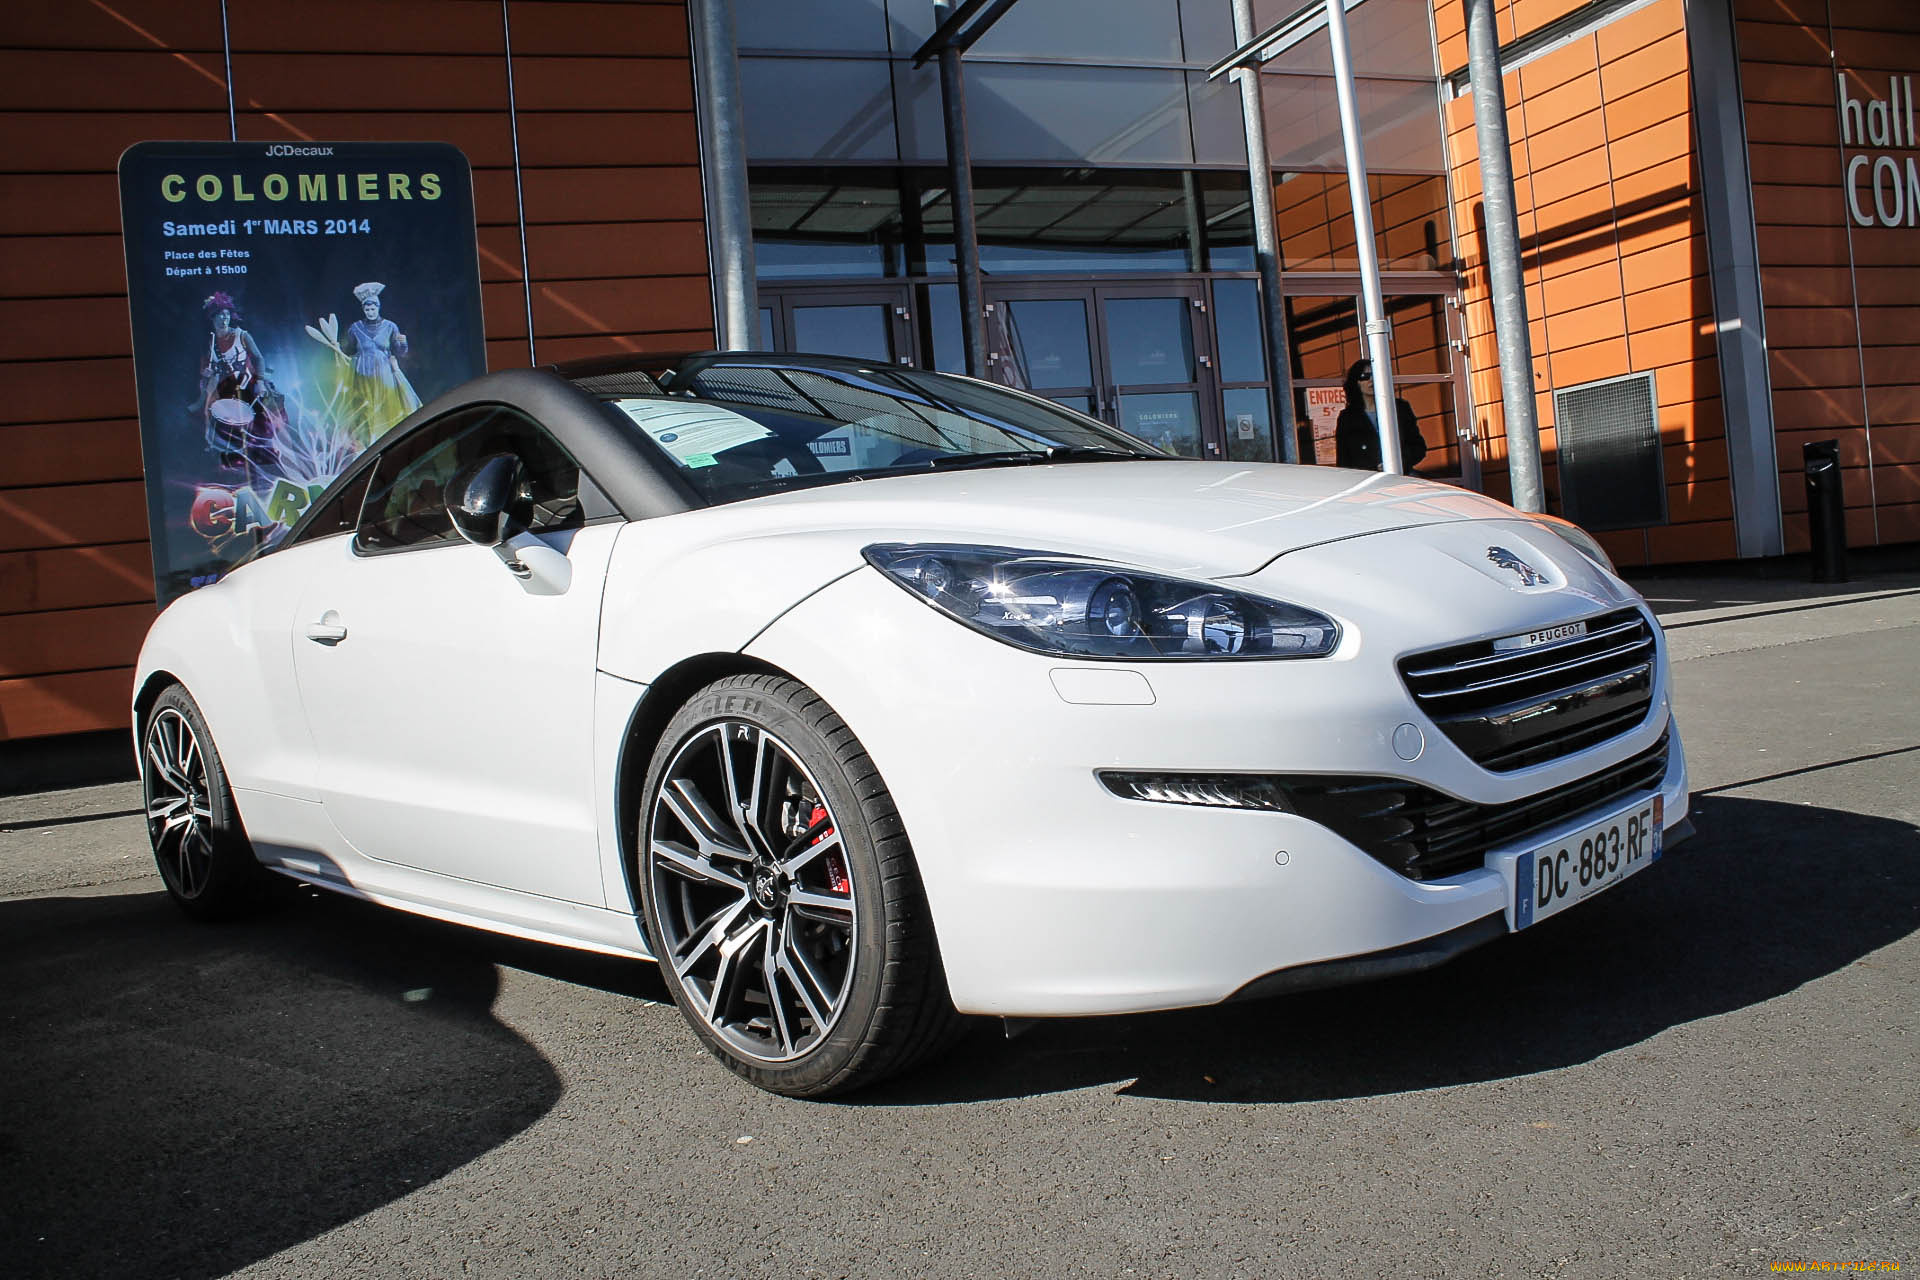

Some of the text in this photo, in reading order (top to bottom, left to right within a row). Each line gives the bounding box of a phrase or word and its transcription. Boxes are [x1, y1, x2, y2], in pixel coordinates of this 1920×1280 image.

[1838, 73, 1915, 146] hall
[265, 145, 334, 157] JCDecaux
[161, 173, 442, 202] COLOMIERS
[162, 220, 236, 236] Samedi
[264, 219, 318, 235] MARS
[324, 218, 371, 235] 2014
[164, 249, 250, 260] Place des Fêtes
[166, 266, 202, 277] Départ
[215, 265, 247, 274] 15h00
[1529, 623, 1581, 645] PEUGEOT
